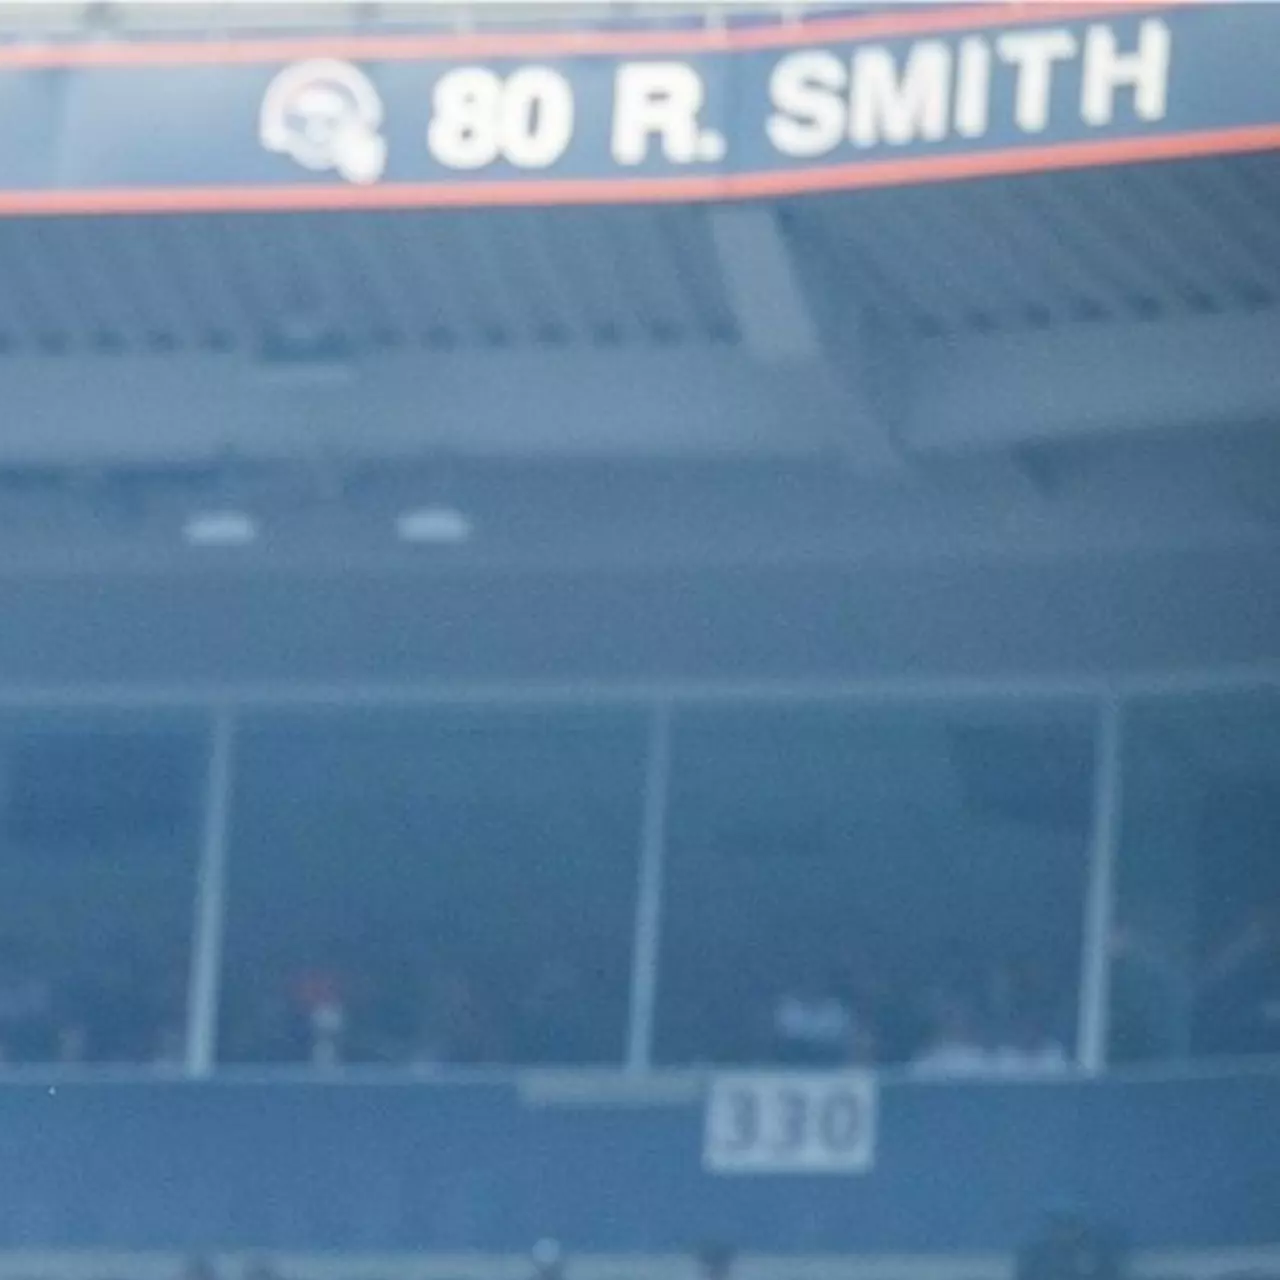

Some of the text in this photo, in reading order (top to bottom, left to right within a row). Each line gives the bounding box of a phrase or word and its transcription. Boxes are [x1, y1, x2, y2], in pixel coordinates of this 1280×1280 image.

[428, 17, 1172, 169] 80 R. SMITH
